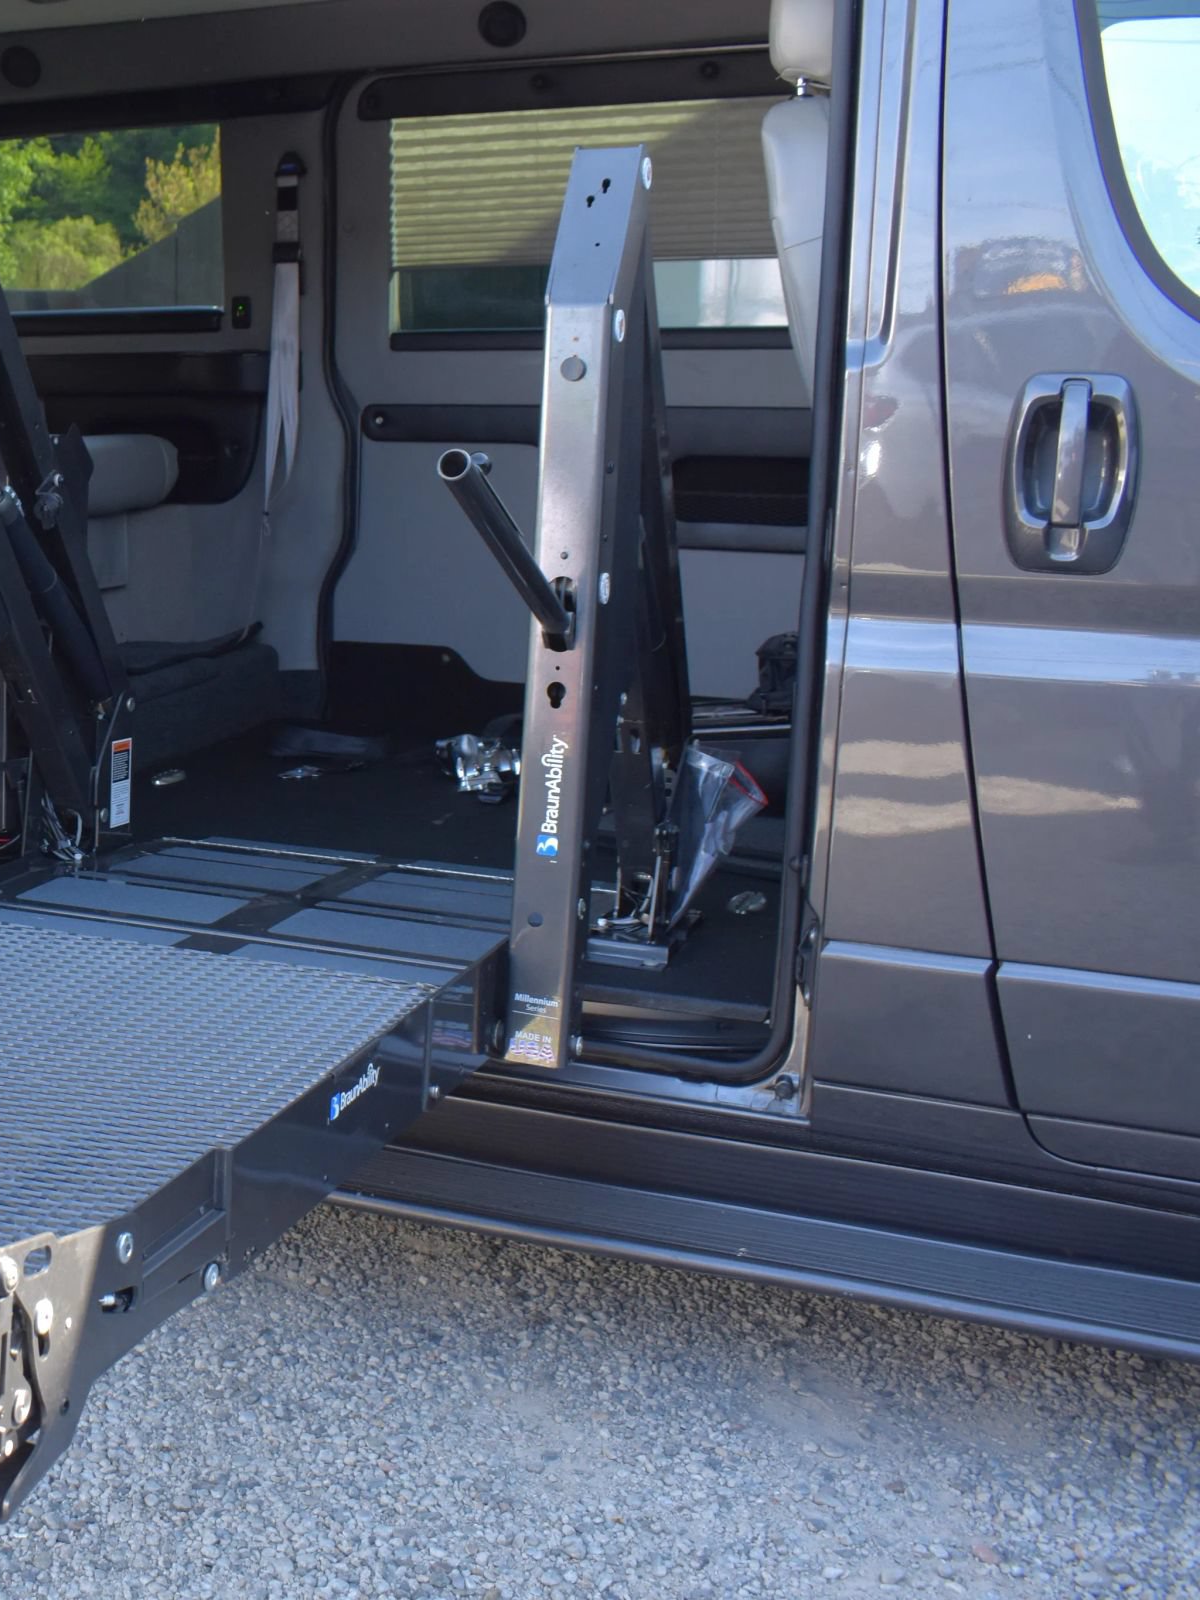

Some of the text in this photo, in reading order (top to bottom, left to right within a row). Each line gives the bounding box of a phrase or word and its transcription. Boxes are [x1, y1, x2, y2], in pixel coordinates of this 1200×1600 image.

[541, 735, 568, 834] BraunAbility
[514, 993, 559, 1008] Millennium
[525, 1003, 546, 1014] Series
[514, 1030, 552, 1044] MADE IN
[509, 1038, 554, 1061] USA
